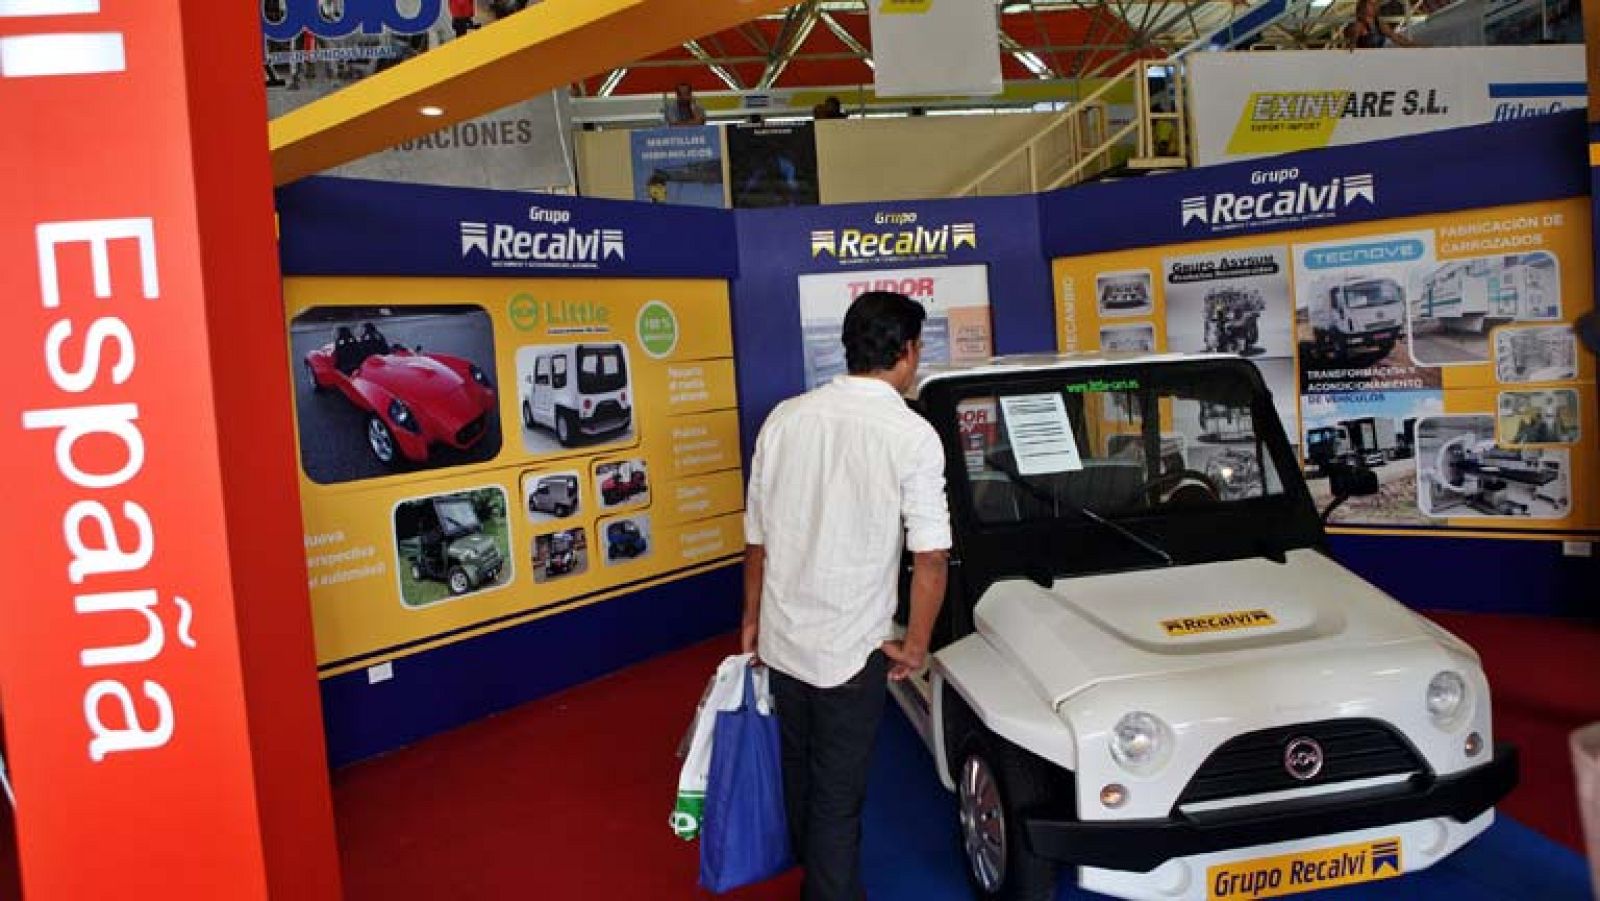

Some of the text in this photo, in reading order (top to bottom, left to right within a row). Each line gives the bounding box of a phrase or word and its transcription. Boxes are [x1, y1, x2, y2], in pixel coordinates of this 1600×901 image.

[1251, 89, 1449, 121] EXINVARE S.L.
[1251, 166, 1300, 185] Grupo
[528, 206, 571, 225] Grupo
[1211, 178, 1341, 223] Recalvi
[874, 211, 918, 226] Grupo
[491, 224, 599, 261] Recalvi
[839, 224, 949, 257] Recalvi
[22, 216, 197, 762] España
[1182, 611, 1252, 632] Recalvi
[1214, 850, 1366, 897] Grupo Recalvi
